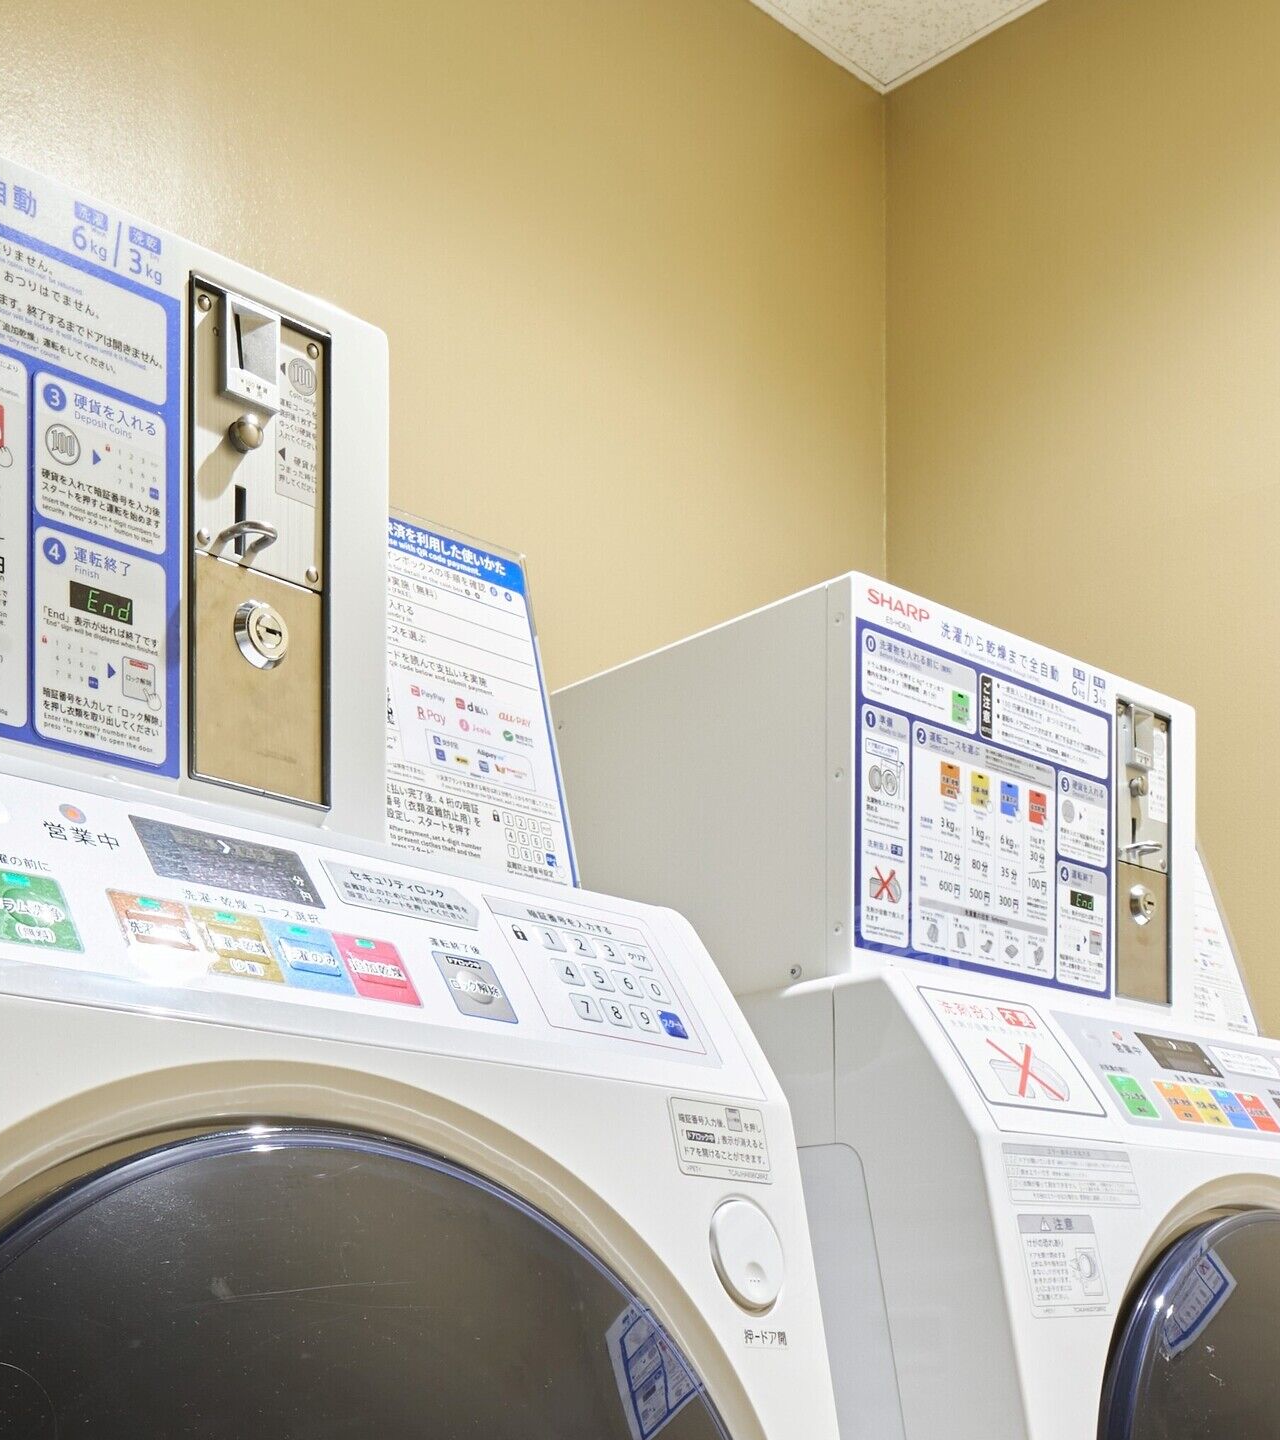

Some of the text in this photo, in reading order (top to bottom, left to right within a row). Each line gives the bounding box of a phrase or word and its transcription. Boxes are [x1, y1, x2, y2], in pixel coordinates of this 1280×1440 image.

[50, 388, 60, 407] 3
[74, 393, 156, 436] 硬貨を入れる
[74, 411, 132, 440] Deposit Coins
[49, 544, 61, 560] 4
[74, 546, 131, 577] 運転終了
[74, 565, 100, 580] Finish
[88, 589, 131, 622] End
[867, 588, 930, 623] SHARP
[940, 620, 1059, 683] 洗濯から乾燥まで全自動
[43, 821, 120, 850] 営業中
[1054, 1217, 1073, 1230] 注意
